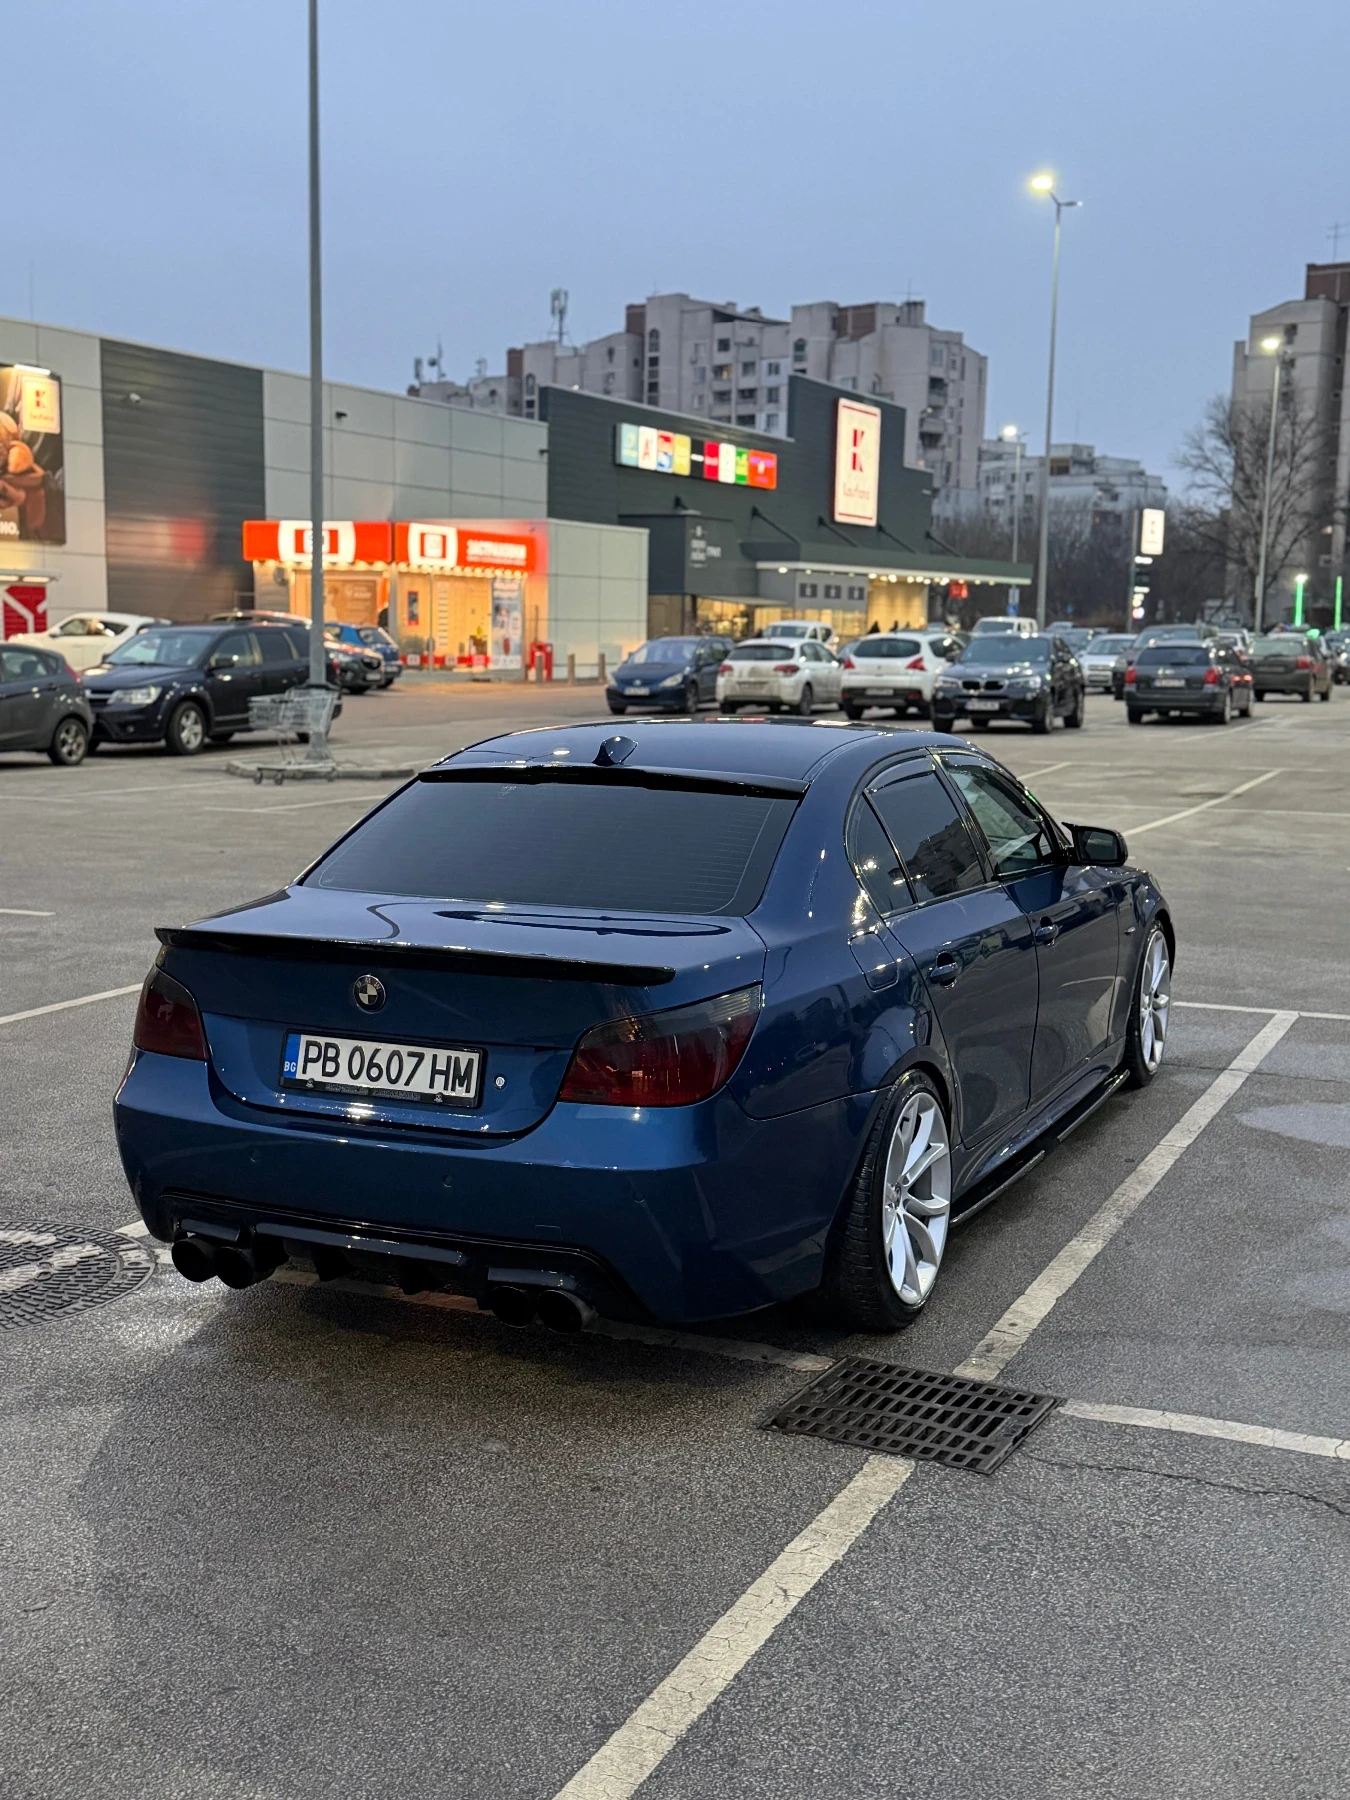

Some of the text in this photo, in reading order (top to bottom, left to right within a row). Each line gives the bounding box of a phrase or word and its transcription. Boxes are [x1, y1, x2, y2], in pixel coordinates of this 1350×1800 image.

[851, 428, 865, 473] K
[284, 1060, 297, 1072] BG
[302, 1039, 475, 1093] PB 0607 HM
